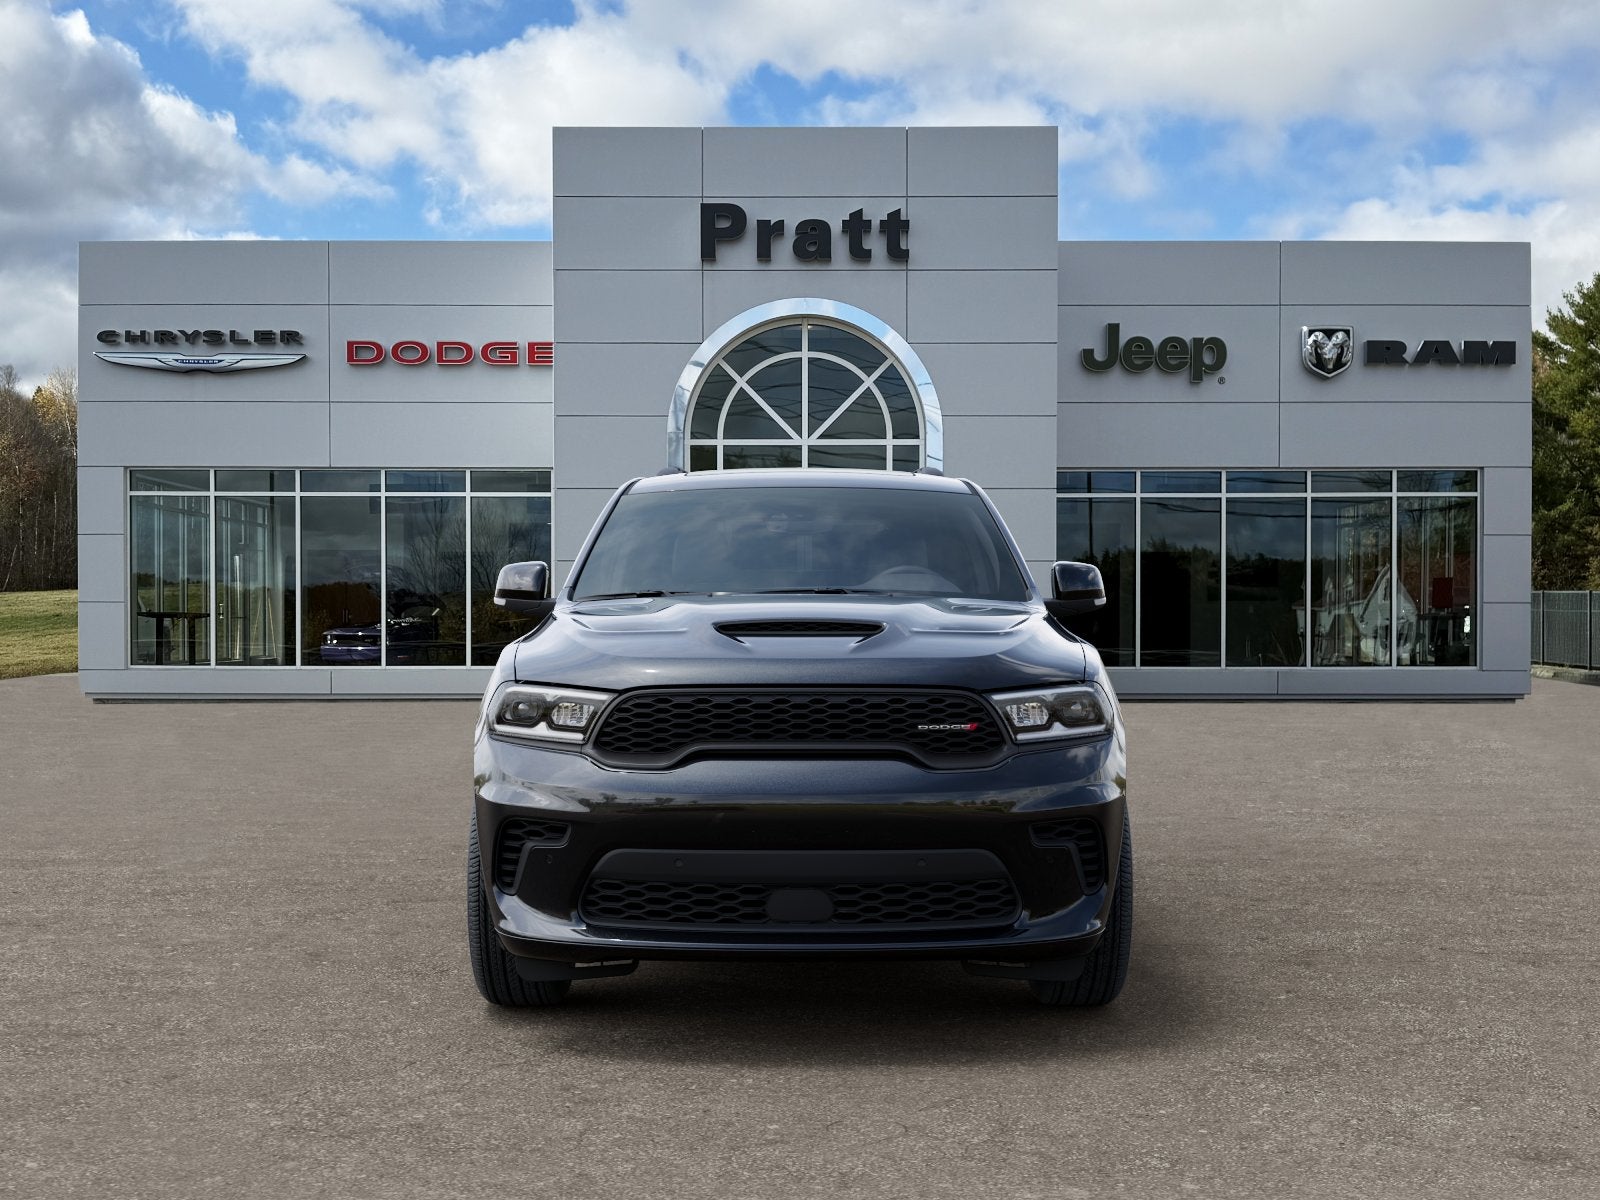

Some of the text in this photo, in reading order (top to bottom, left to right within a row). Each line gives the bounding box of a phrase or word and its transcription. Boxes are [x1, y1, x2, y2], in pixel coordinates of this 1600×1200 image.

[700, 202, 910, 262] Pratt
[96, 329, 304, 345] CHRYSLER
[346, 340, 554, 365] DODGE
[1081, 322, 1228, 384] Jeep
[1364, 340, 1517, 366] RAM
